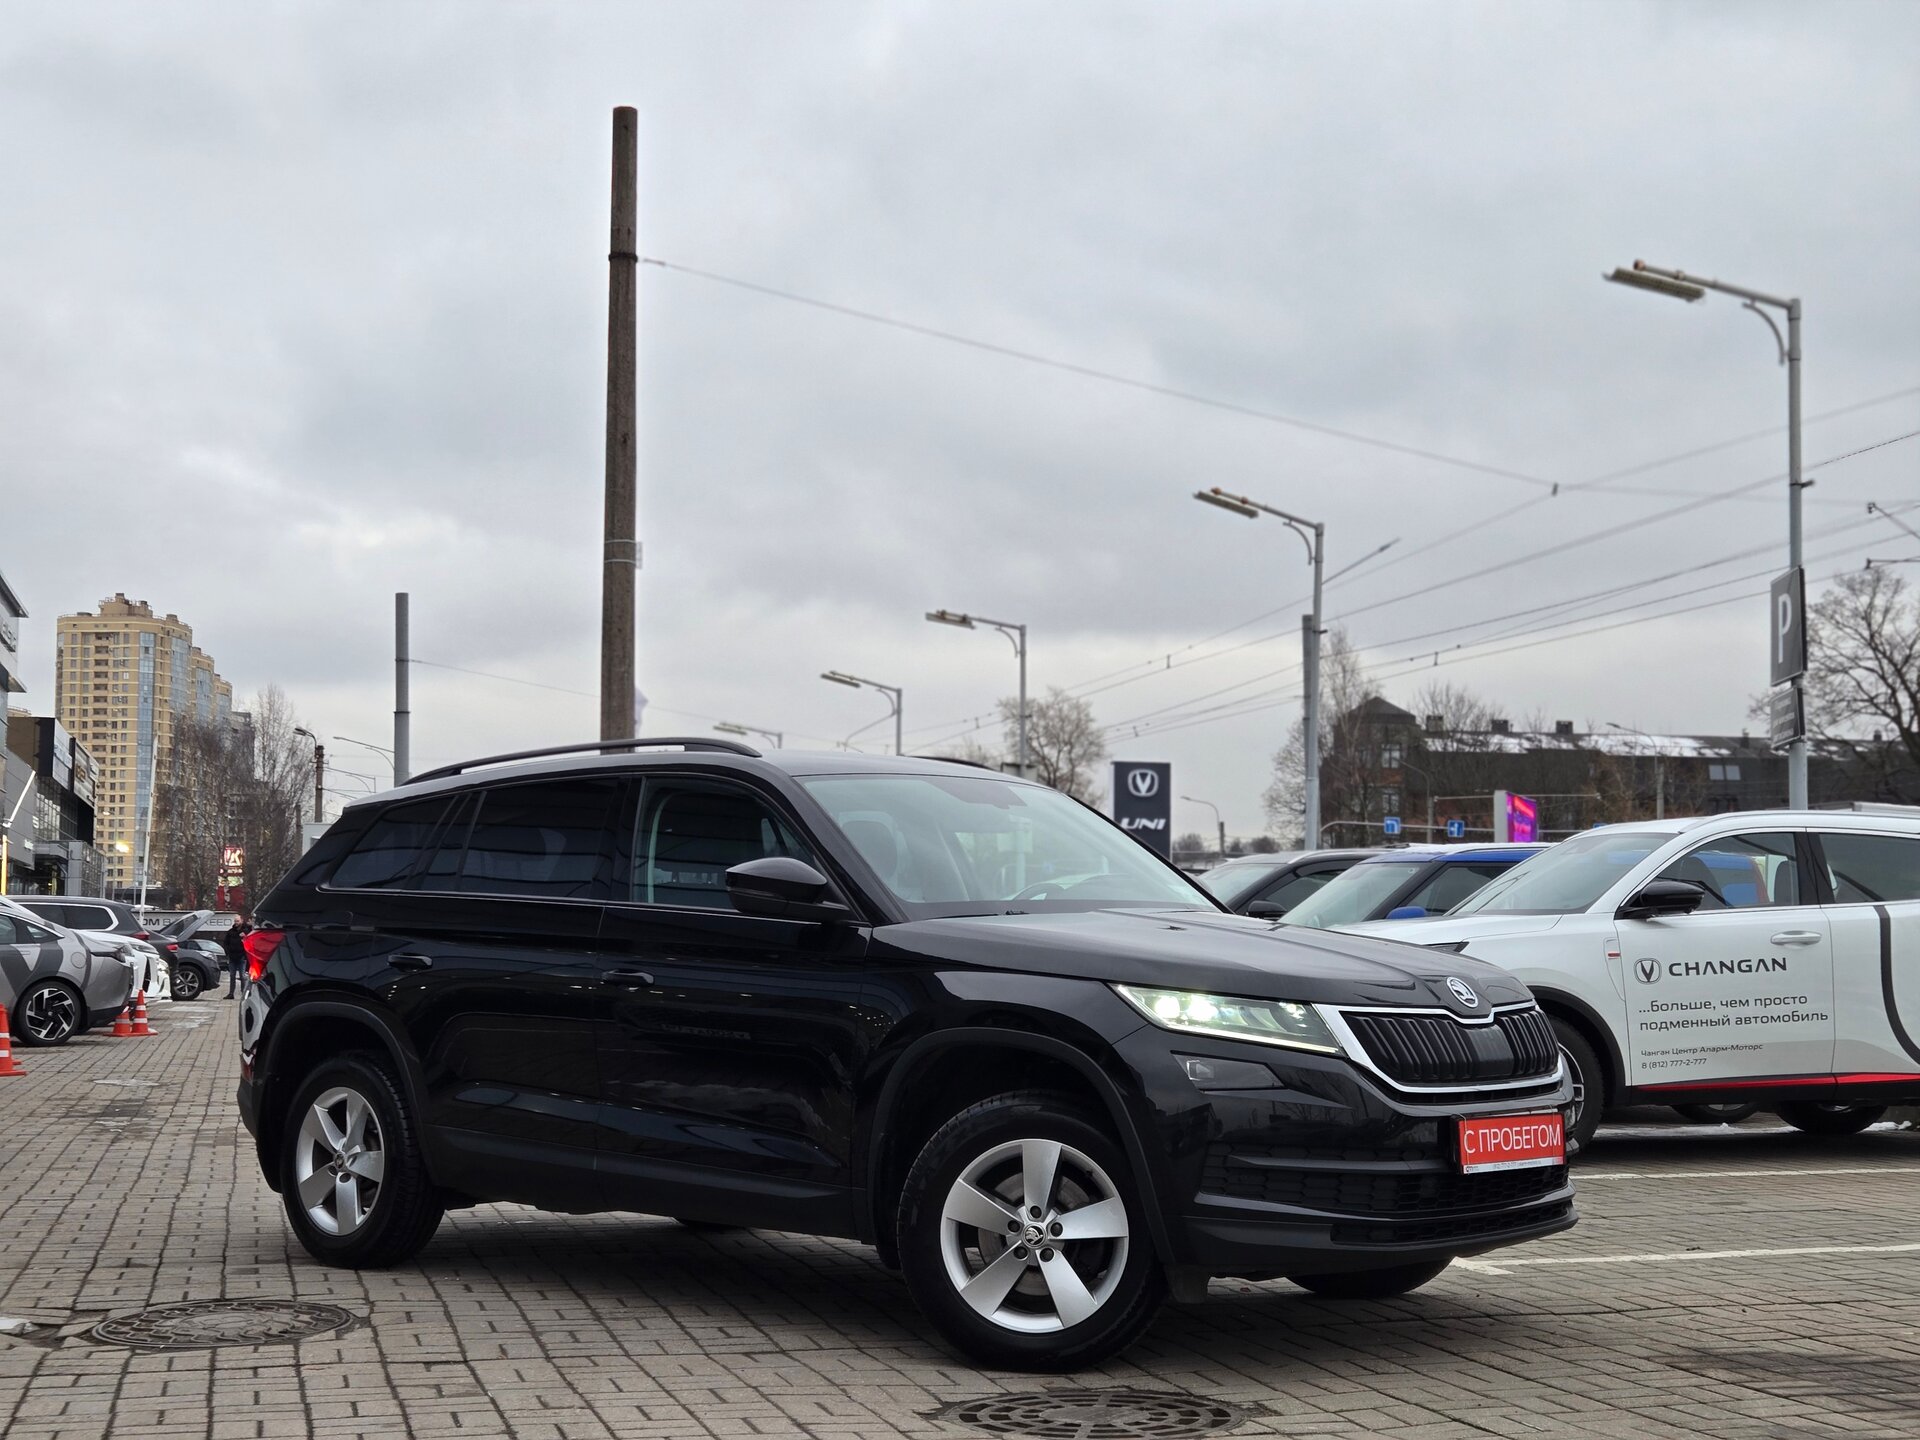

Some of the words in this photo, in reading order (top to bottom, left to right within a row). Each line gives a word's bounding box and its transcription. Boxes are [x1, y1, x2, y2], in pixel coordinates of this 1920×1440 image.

[1778, 593, 1792, 664] P
[1120, 817, 1166, 830] UNI
[1668, 957, 1788, 977] CHANGAN
[1639, 1000, 1717, 1014] ...больше,
[1720, 998, 1750, 1008] чем
[1754, 995, 1808, 1008] просто
[1640, 1014, 1731, 1032] подменный
[1735, 1010, 1829, 1026] автомобиль
[1641, 1049, 1670, 1057] Чанган
[1672, 1047, 1698, 1056] Центр
[1699, 1044, 1763, 1054] Аларм-Моторс
[1649, 1060, 1668, 1069] (812)
[1670, 1058, 1707, 1067] 777-2-777
[1463, 1130, 1476, 1153] С
[1479, 1124, 1561, 1152] ПРОБЕГОМ
